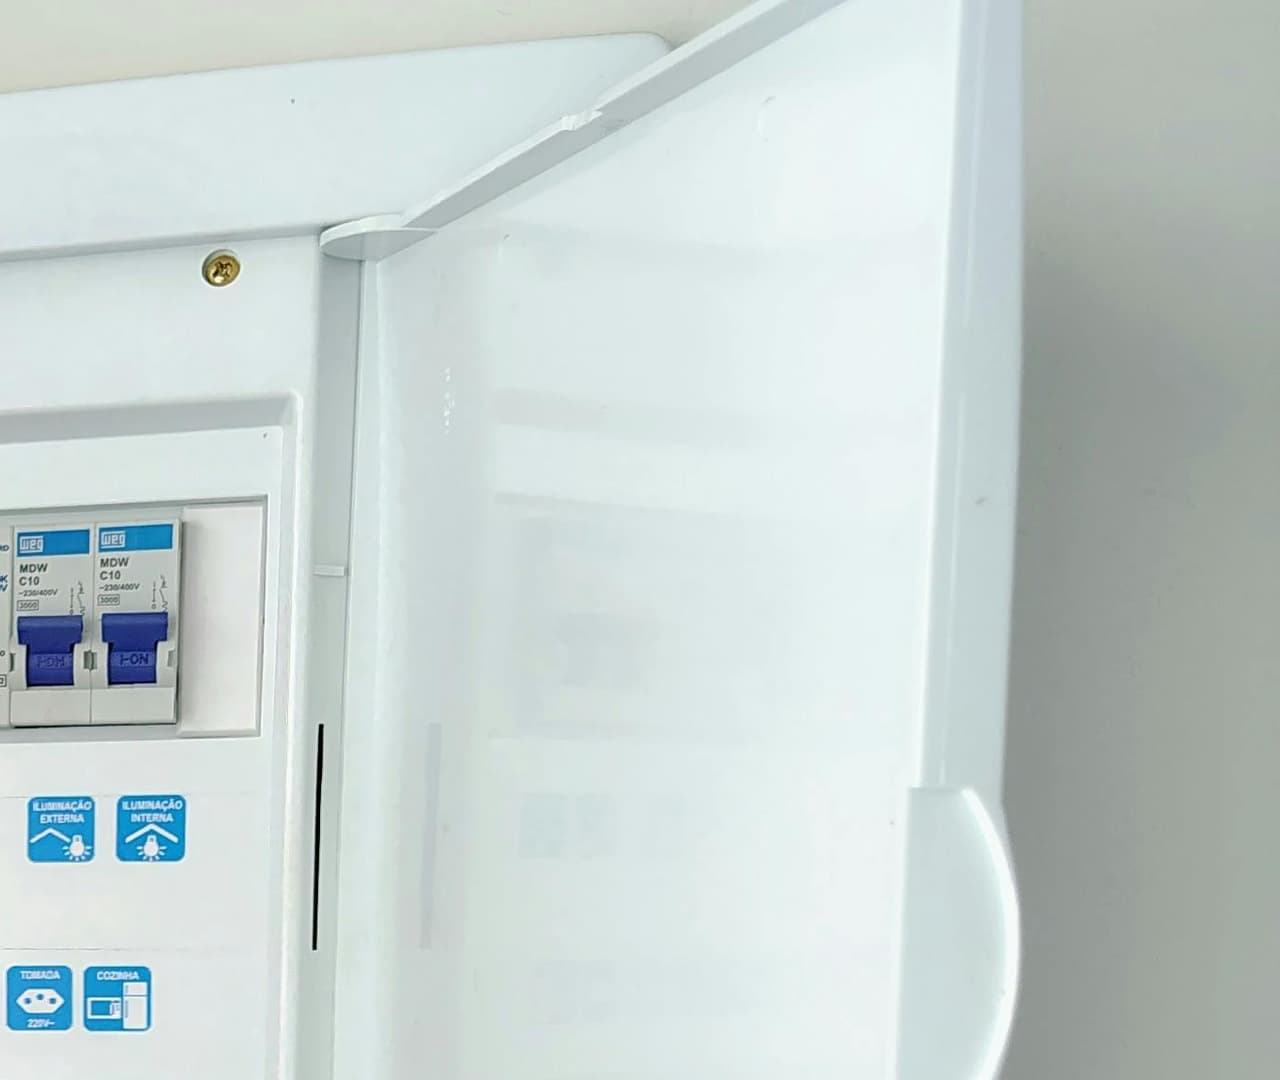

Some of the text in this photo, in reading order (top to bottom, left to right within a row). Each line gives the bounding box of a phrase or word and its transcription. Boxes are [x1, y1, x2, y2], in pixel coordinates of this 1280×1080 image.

[19, 563, 48, 573] MDW
[100, 557, 129, 568] MDW
[100, 570, 121, 580] C10
[19, 577, 40, 586] C10
[32, 799, 92, 812] ILUMINAÇÃO
[122, 798, 183, 812] ILUMINAÇÃO
[40, 813, 85, 824] EXTERNA
[130, 812, 174, 823] INTERNA
[96, 970, 140, 981] COZINHA
